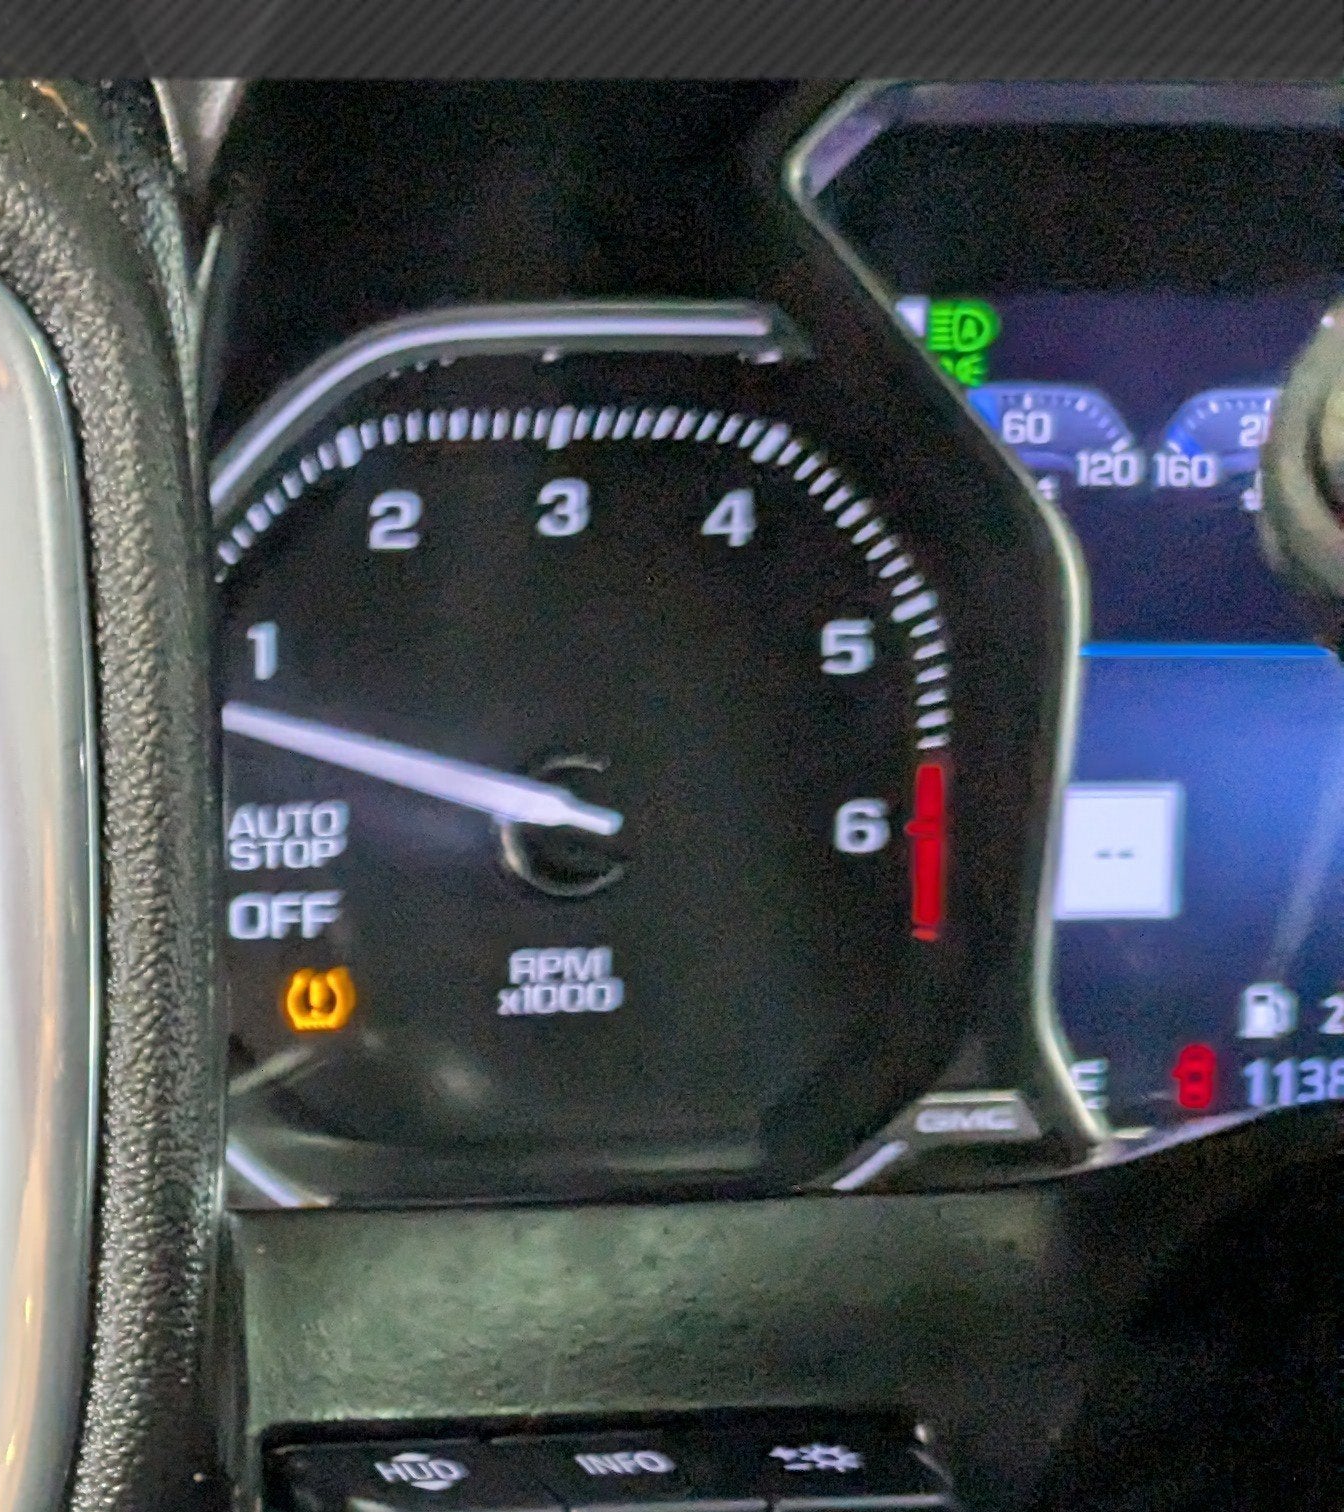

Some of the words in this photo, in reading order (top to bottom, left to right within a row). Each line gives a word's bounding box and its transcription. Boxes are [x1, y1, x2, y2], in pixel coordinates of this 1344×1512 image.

[1001, 410, 1052, 444] 60
[1076, 451, 1139, 487] 120
[1154, 453, 1219, 488] 160
[367, 489, 423, 551] 2
[536, 477, 592, 537] 3
[701, 488, 757, 548] 4
[246, 621, 279, 681] 1
[819, 618, 876, 676] 5
[228, 800, 350, 840] AUTO
[834, 798, 891, 855] 6
[229, 836, 348, 871] STOP
[228, 889, 344, 940] OFF
[508, 946, 612, 984] RPM
[374, 1458, 468, 1484] HUD
[574, 1450, 675, 1476] INFO
